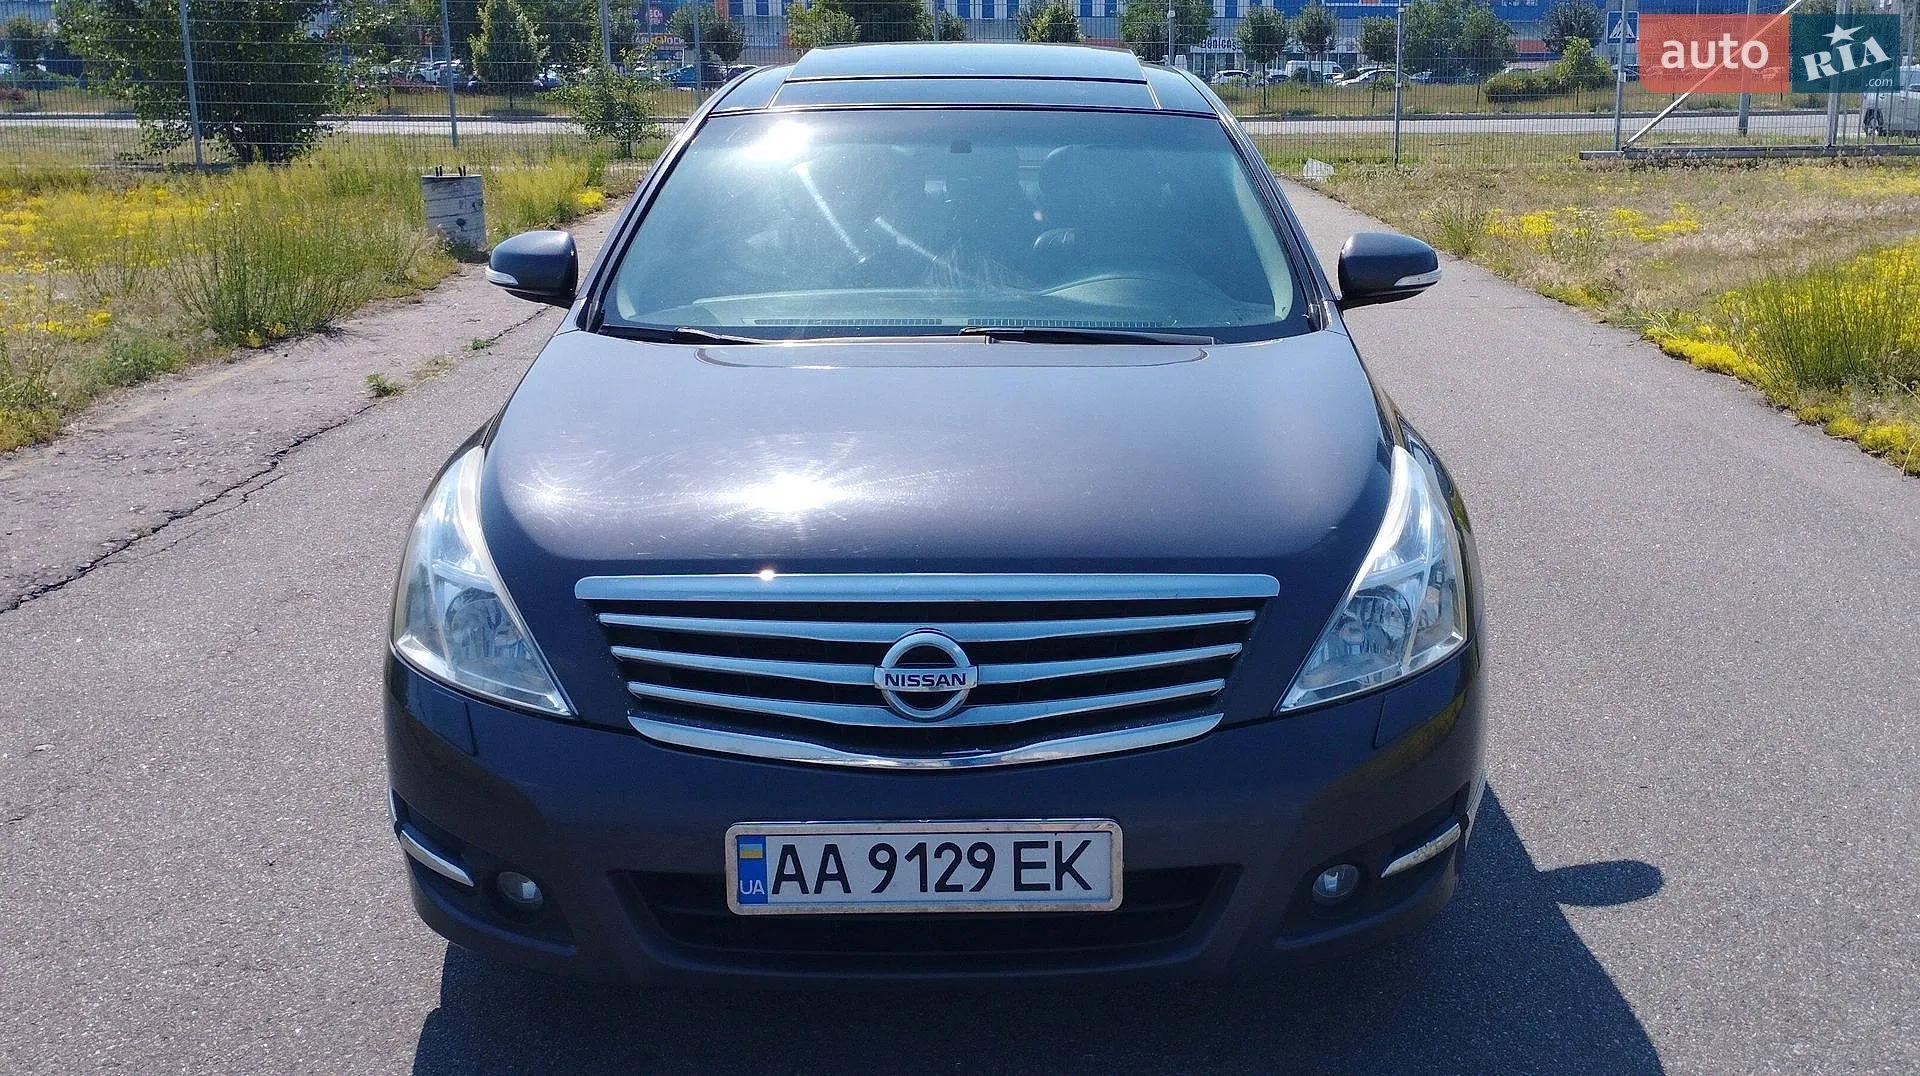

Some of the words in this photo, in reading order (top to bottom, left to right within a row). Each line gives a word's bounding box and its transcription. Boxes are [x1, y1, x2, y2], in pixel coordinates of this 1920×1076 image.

[885, 673, 967, 687] NISSAN
[772, 844, 851, 895] AA
[868, 841, 996, 894] 9129
[1013, 840, 1092, 892] EK
[740, 879, 765, 896] UA
